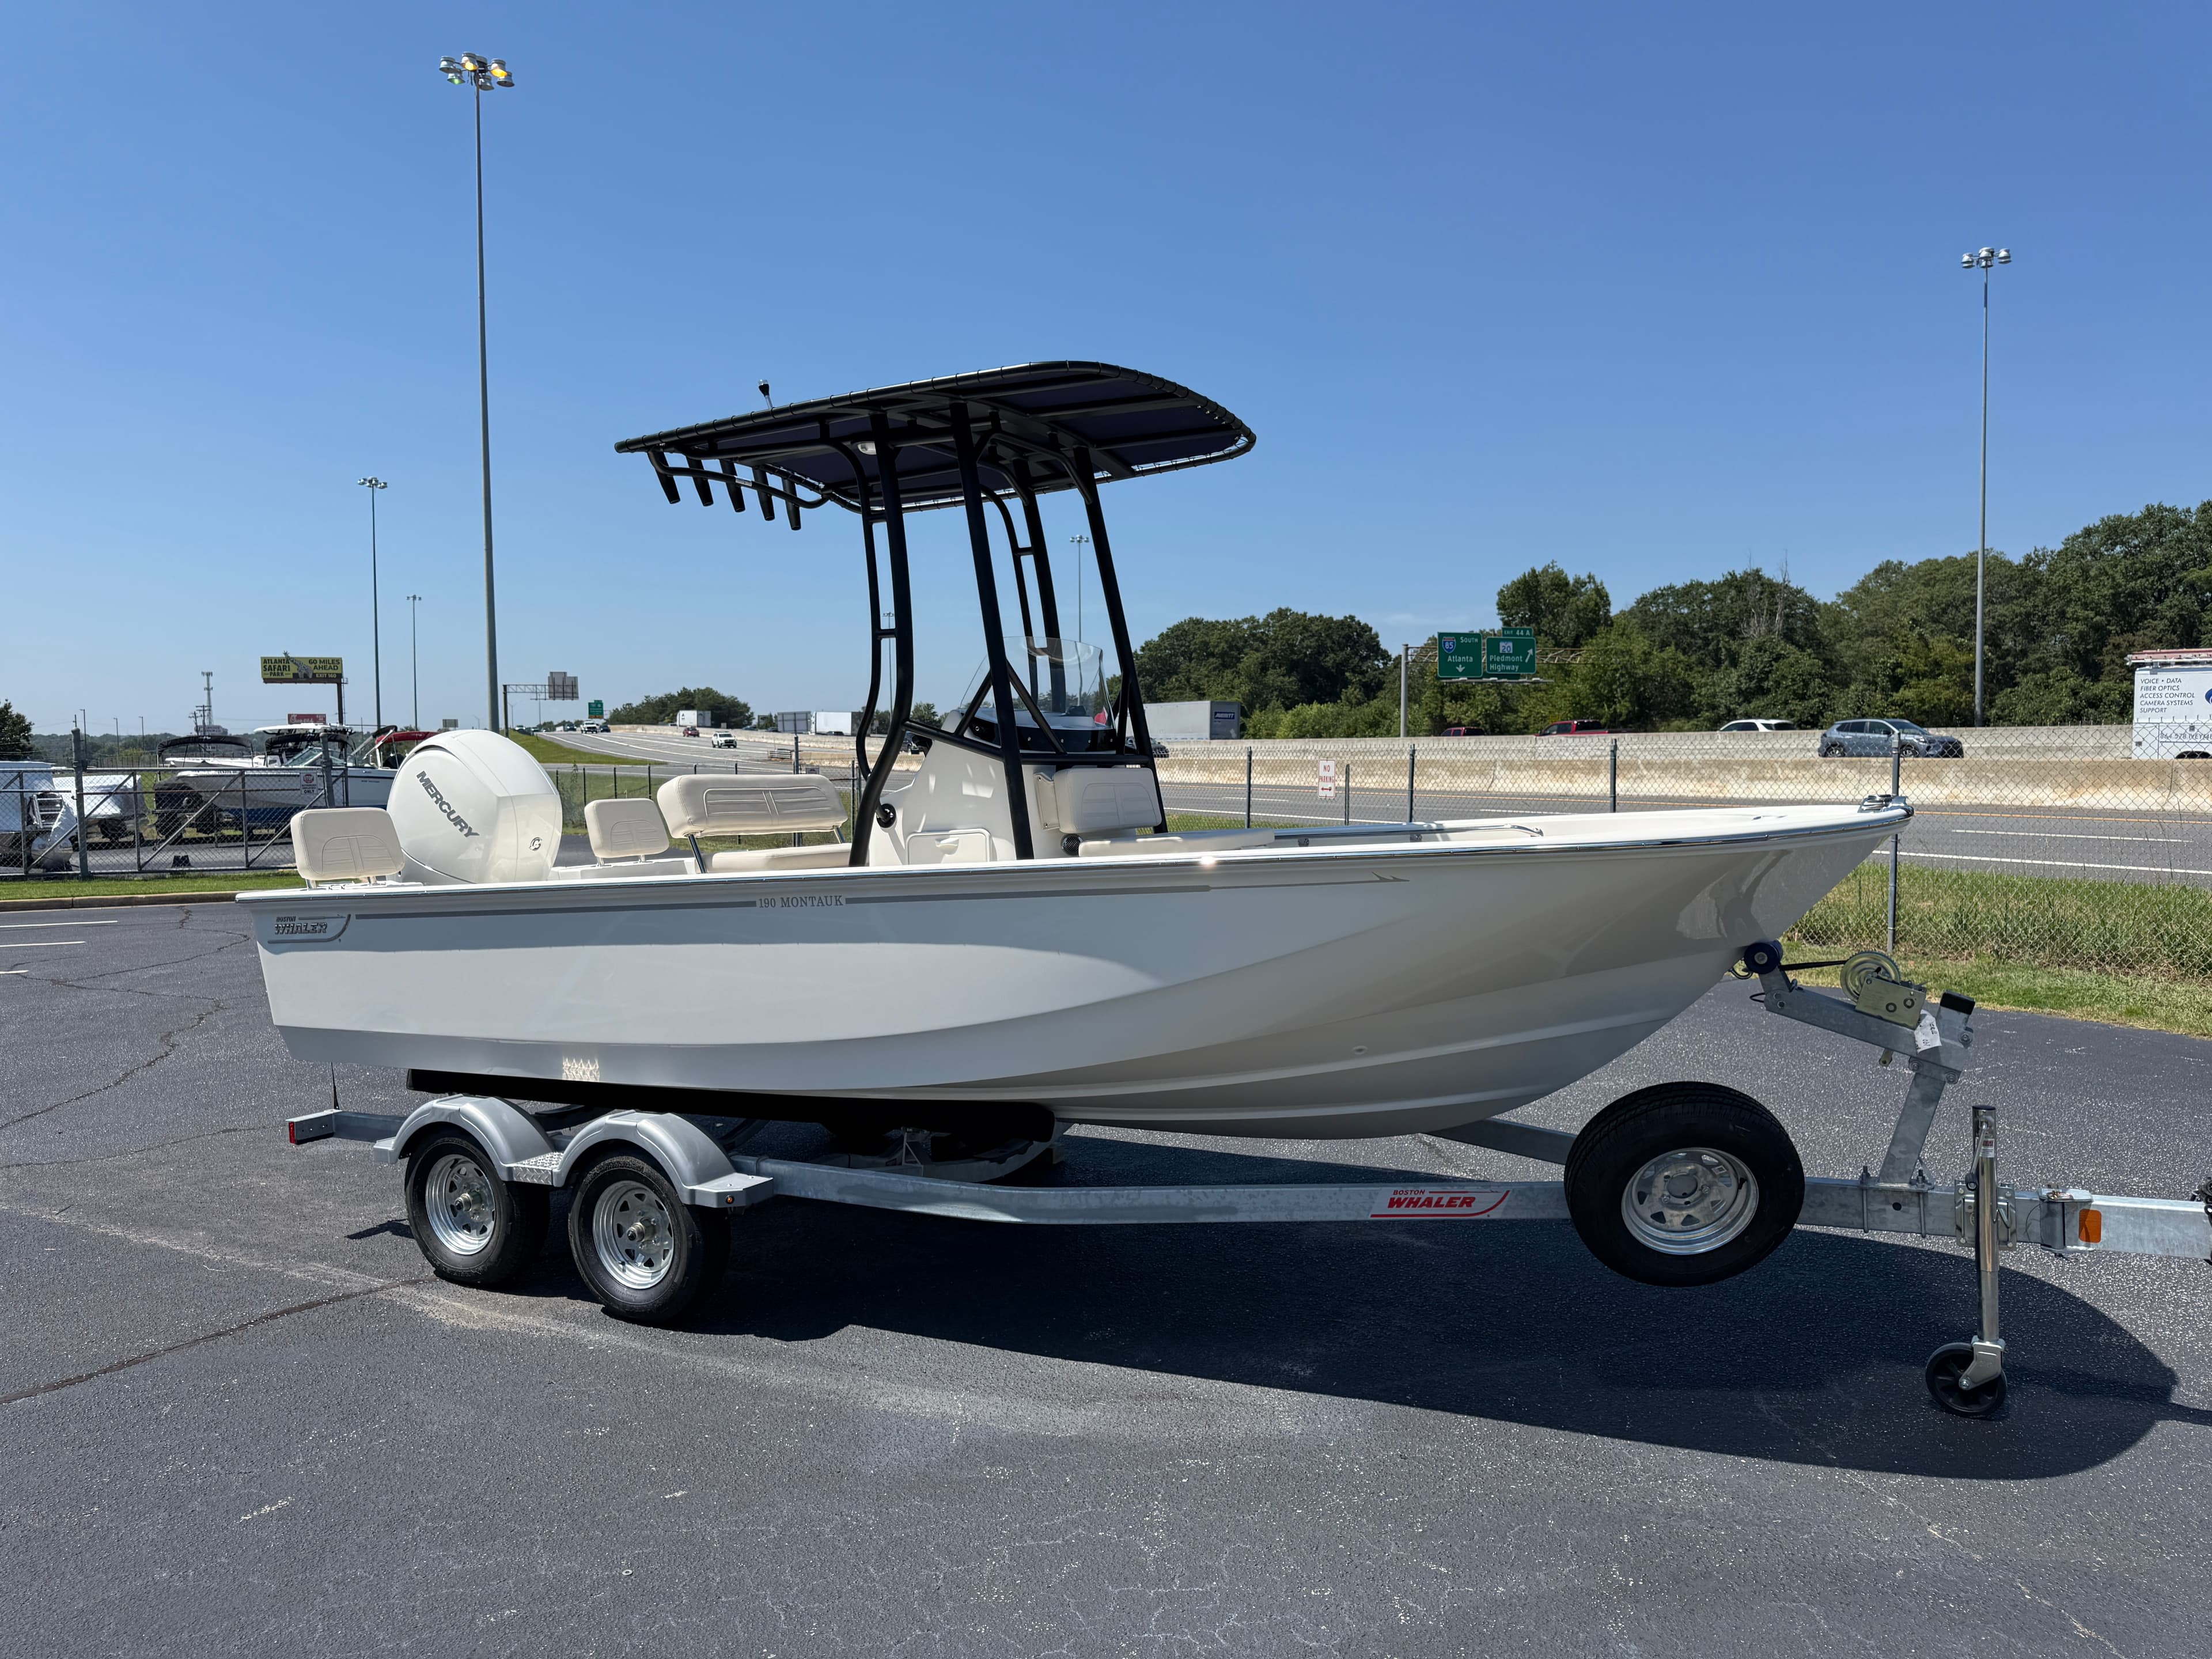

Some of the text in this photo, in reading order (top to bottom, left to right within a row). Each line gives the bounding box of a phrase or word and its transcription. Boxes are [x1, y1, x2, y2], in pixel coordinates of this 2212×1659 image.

[1490, 664, 1519, 672] Highway
[1323, 764, 1331, 772] NO
[416, 770, 480, 838] MERCURY
[759, 895, 844, 908] 190 MONTAUK
[274, 922, 328, 934] WHALER
[1387, 1196, 1476, 1209] WHALER
